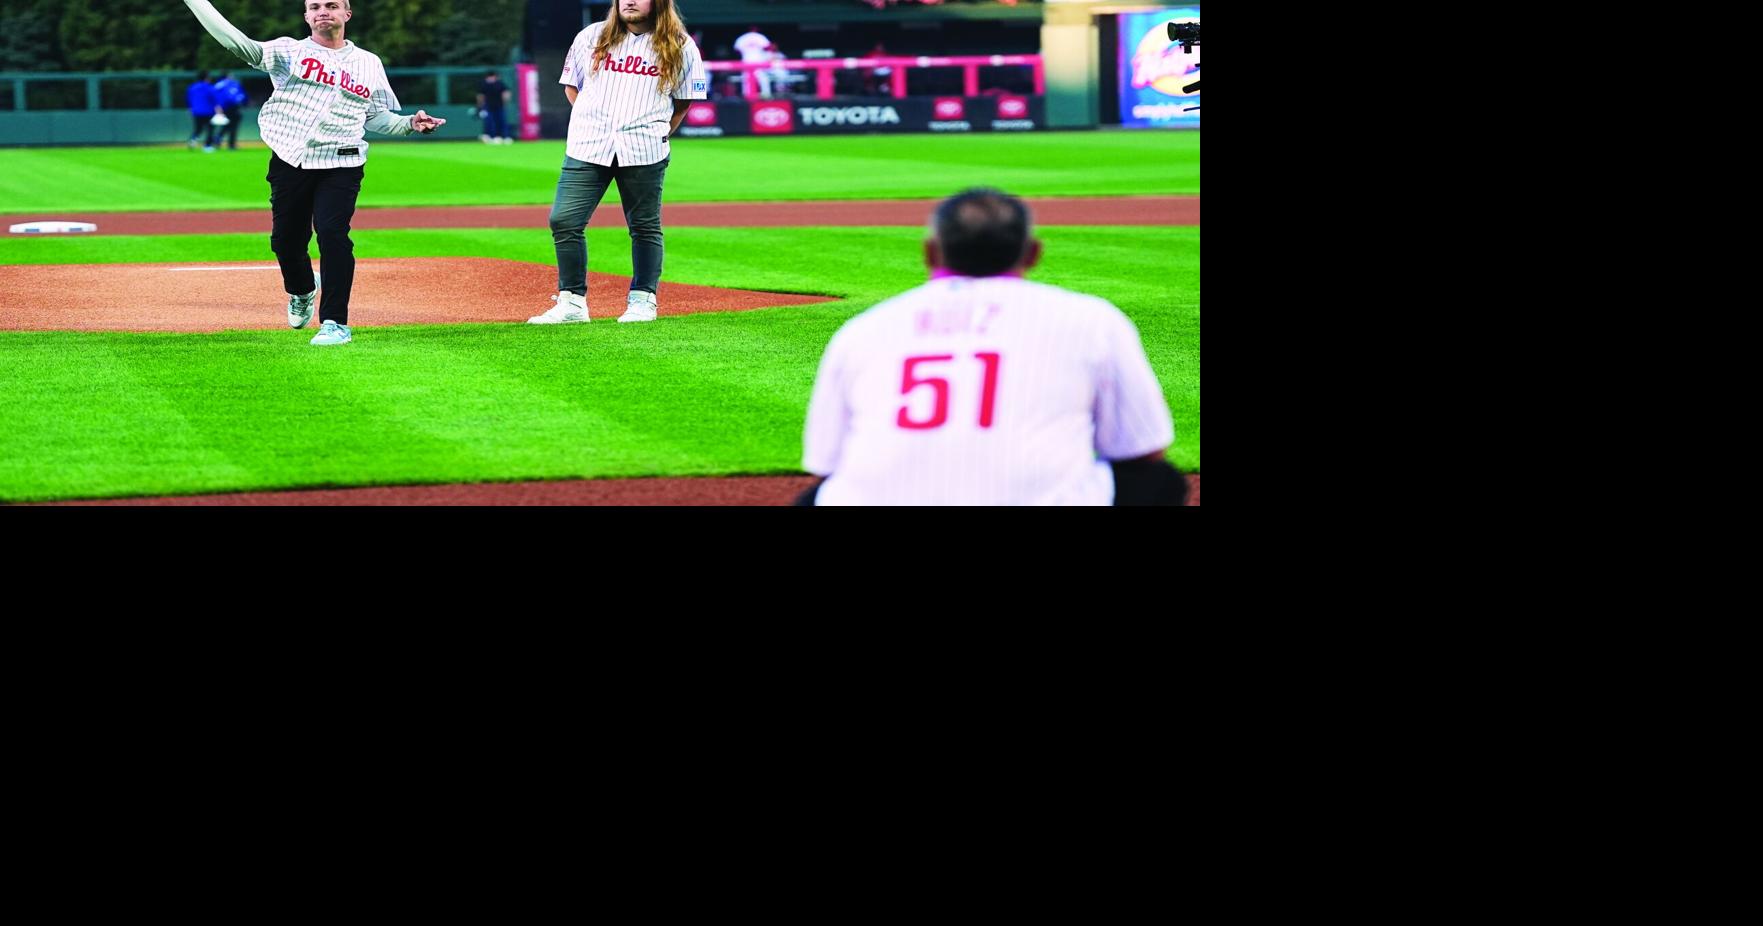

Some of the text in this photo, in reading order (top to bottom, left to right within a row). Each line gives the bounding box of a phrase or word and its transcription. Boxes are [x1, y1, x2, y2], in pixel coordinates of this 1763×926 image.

[301, 57, 371, 98] Phillies
[798, 105, 900, 126] TOYOTA
[897, 352, 1000, 429] 51
